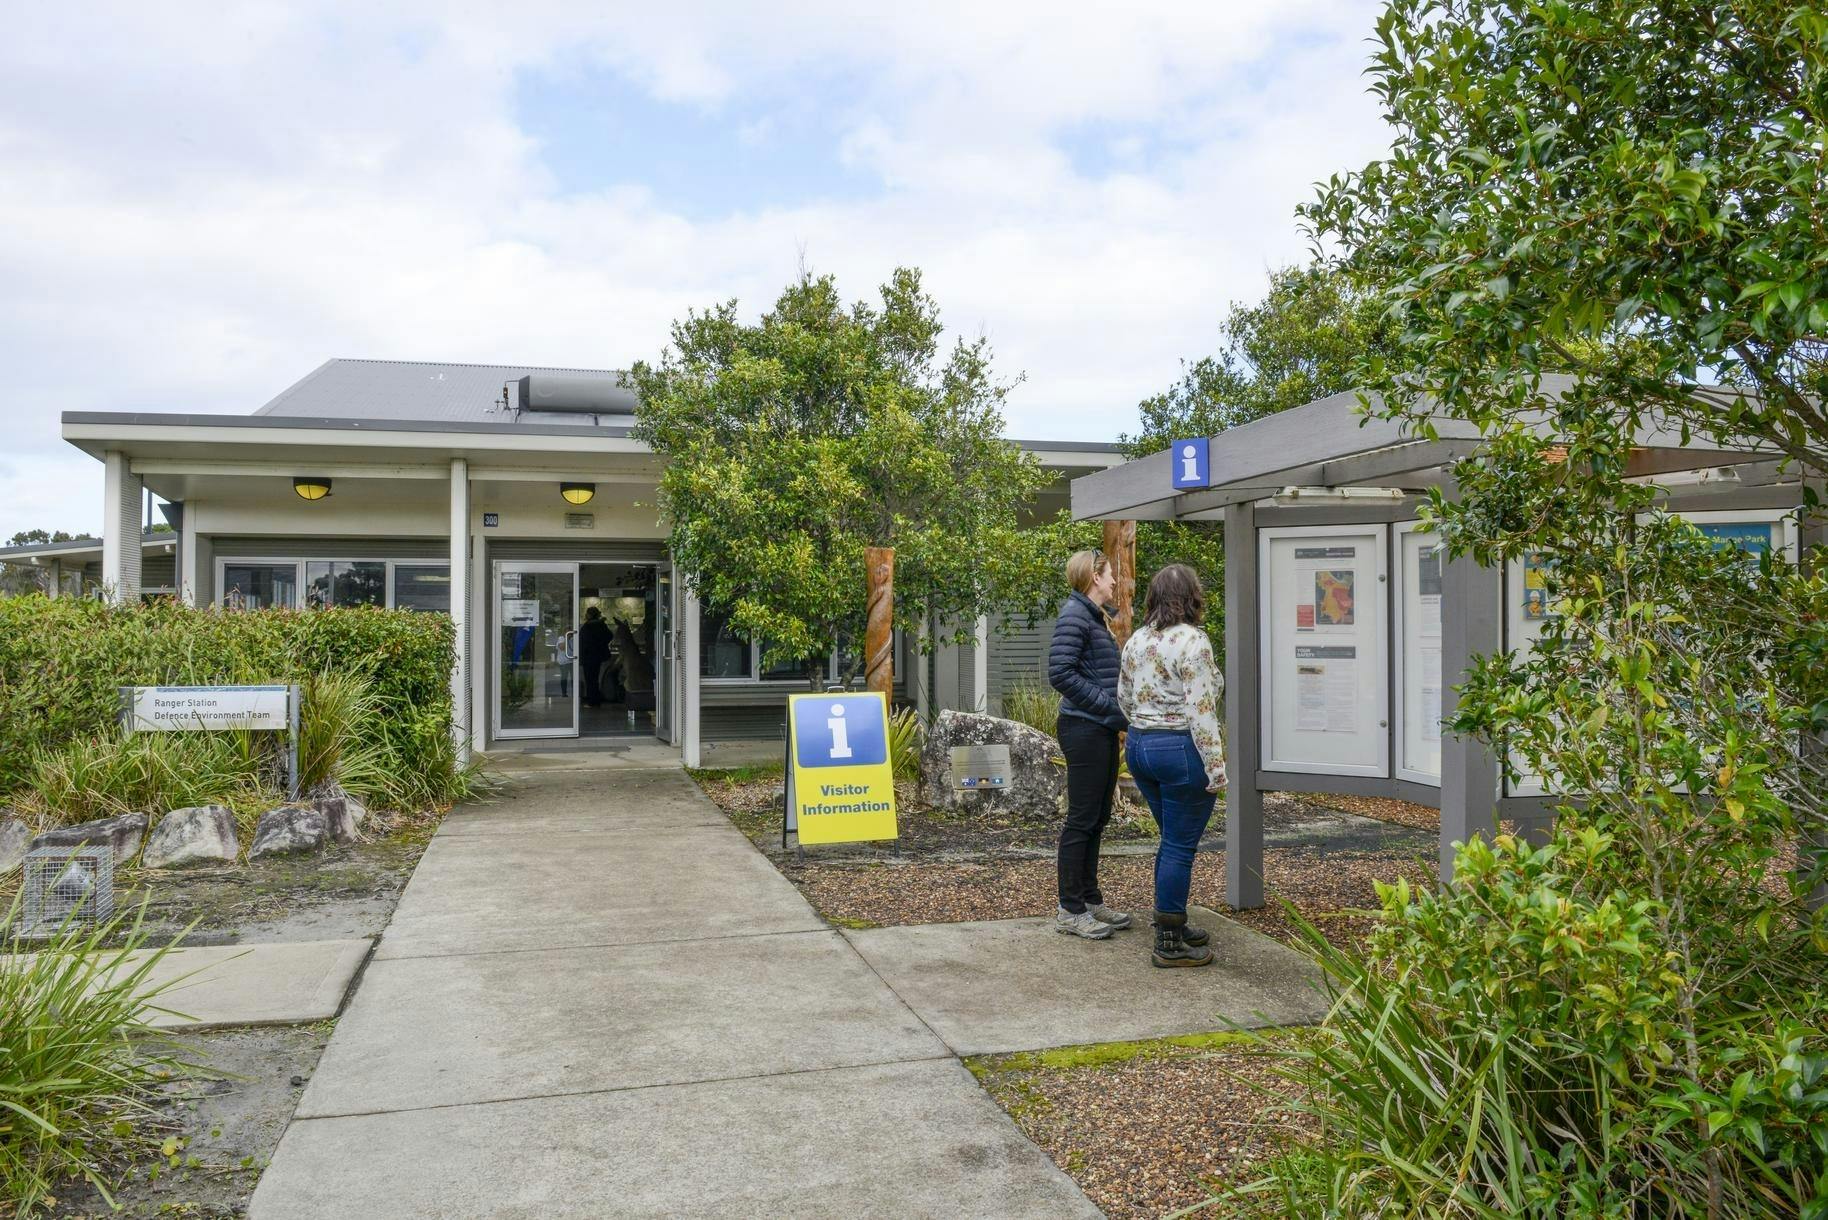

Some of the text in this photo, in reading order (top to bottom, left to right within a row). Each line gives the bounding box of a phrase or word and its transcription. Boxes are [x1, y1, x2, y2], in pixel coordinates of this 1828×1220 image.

[485, 515, 497, 525] 300
[1712, 535, 1743, 544] Marne
[1745, 534, 1767, 543] Park
[154, 699, 217, 709] Ranger Station
[154, 711, 270, 720] Defence Environment Team
[820, 784, 870, 797] Visitor
[802, 800, 890, 816] Information
